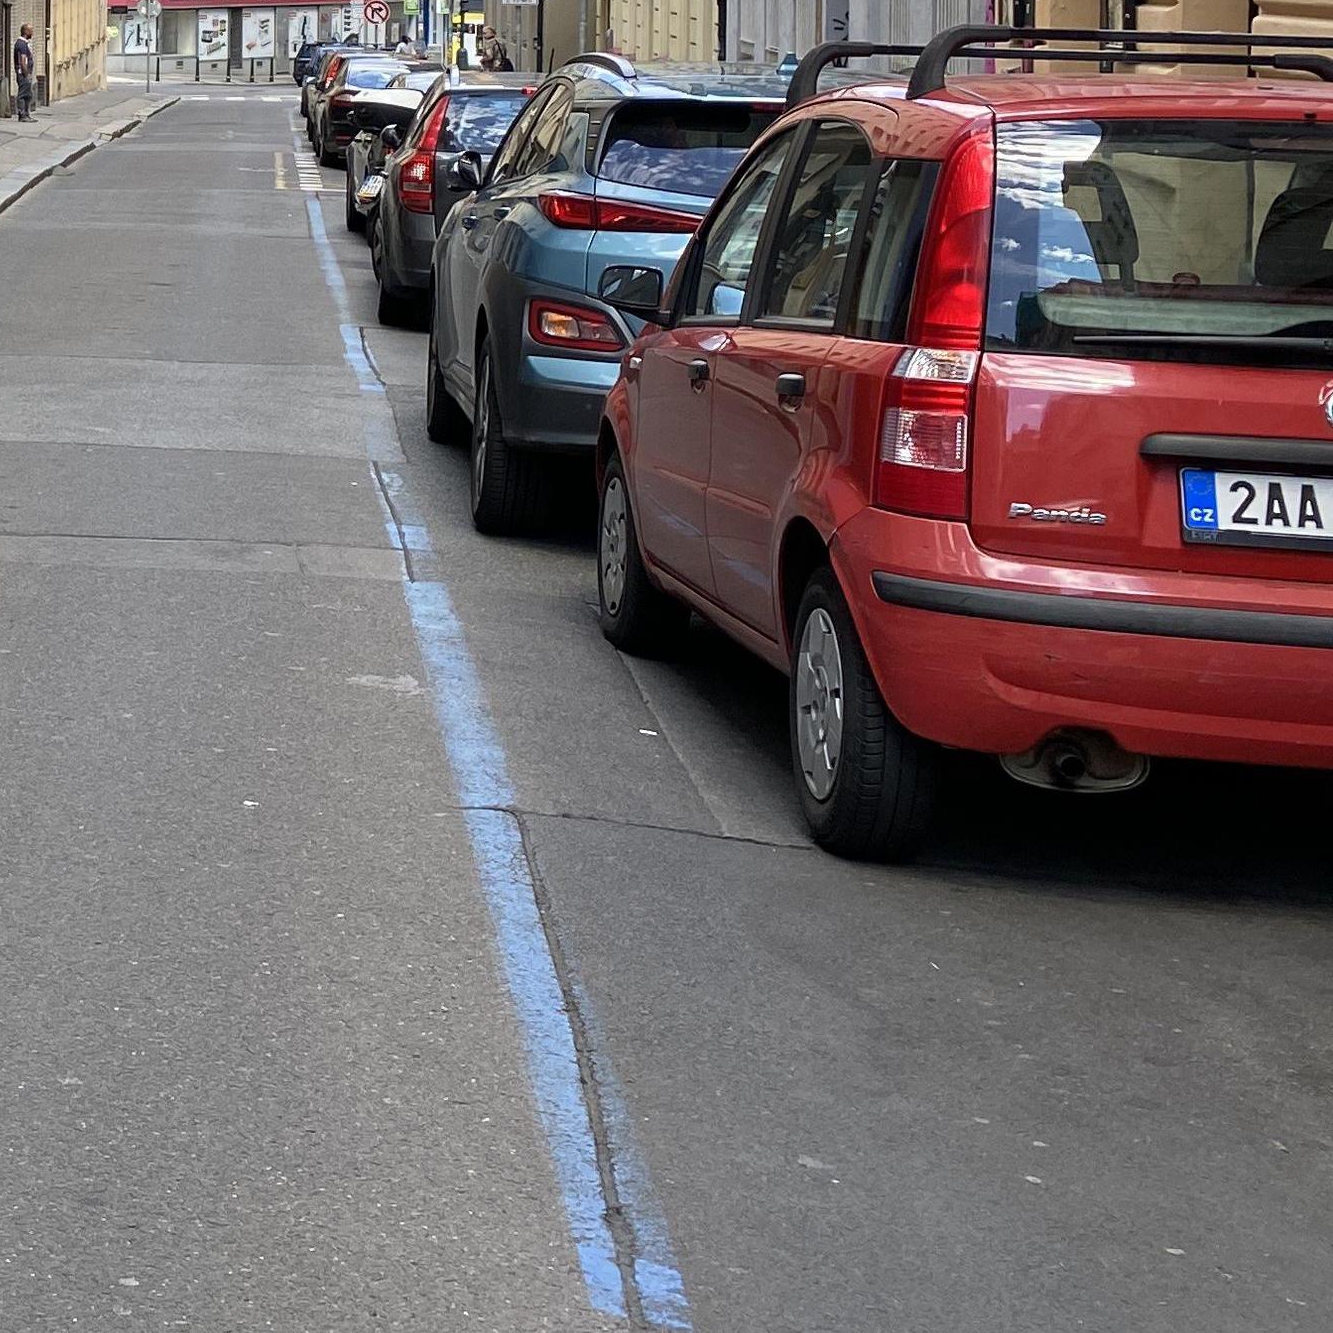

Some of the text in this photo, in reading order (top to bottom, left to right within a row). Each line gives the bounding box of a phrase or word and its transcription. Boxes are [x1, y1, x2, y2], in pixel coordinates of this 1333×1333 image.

[1008, 502, 1107, 525] Panda
[1190, 507, 1215, 523] CZ
[1229, 480, 1324, 529] 2AA
